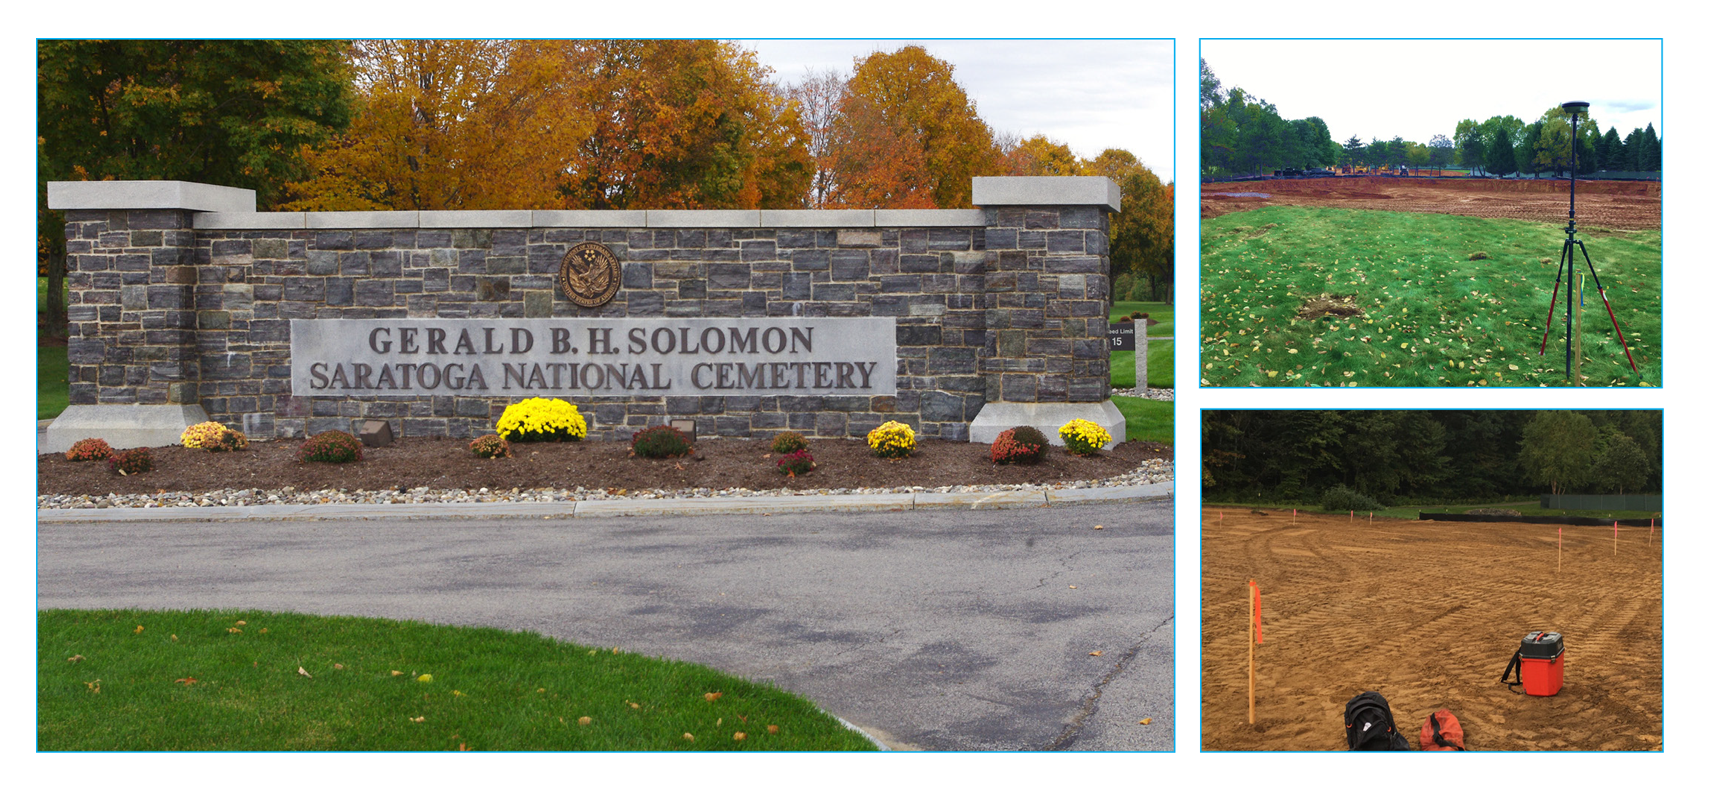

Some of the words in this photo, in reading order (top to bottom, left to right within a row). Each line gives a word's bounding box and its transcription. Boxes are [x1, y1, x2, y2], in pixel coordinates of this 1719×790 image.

[368, 327, 534, 355] GERALD
[550, 327, 579, 355] B.
[587, 327, 620, 355] H.
[628, 327, 815, 355] SOLOMON
[1112, 337, 1123, 346] 15
[309, 362, 489, 390] SARATOGA
[501, 362, 672, 391] NATIONAL
[690, 361, 878, 390] CEMETERY
